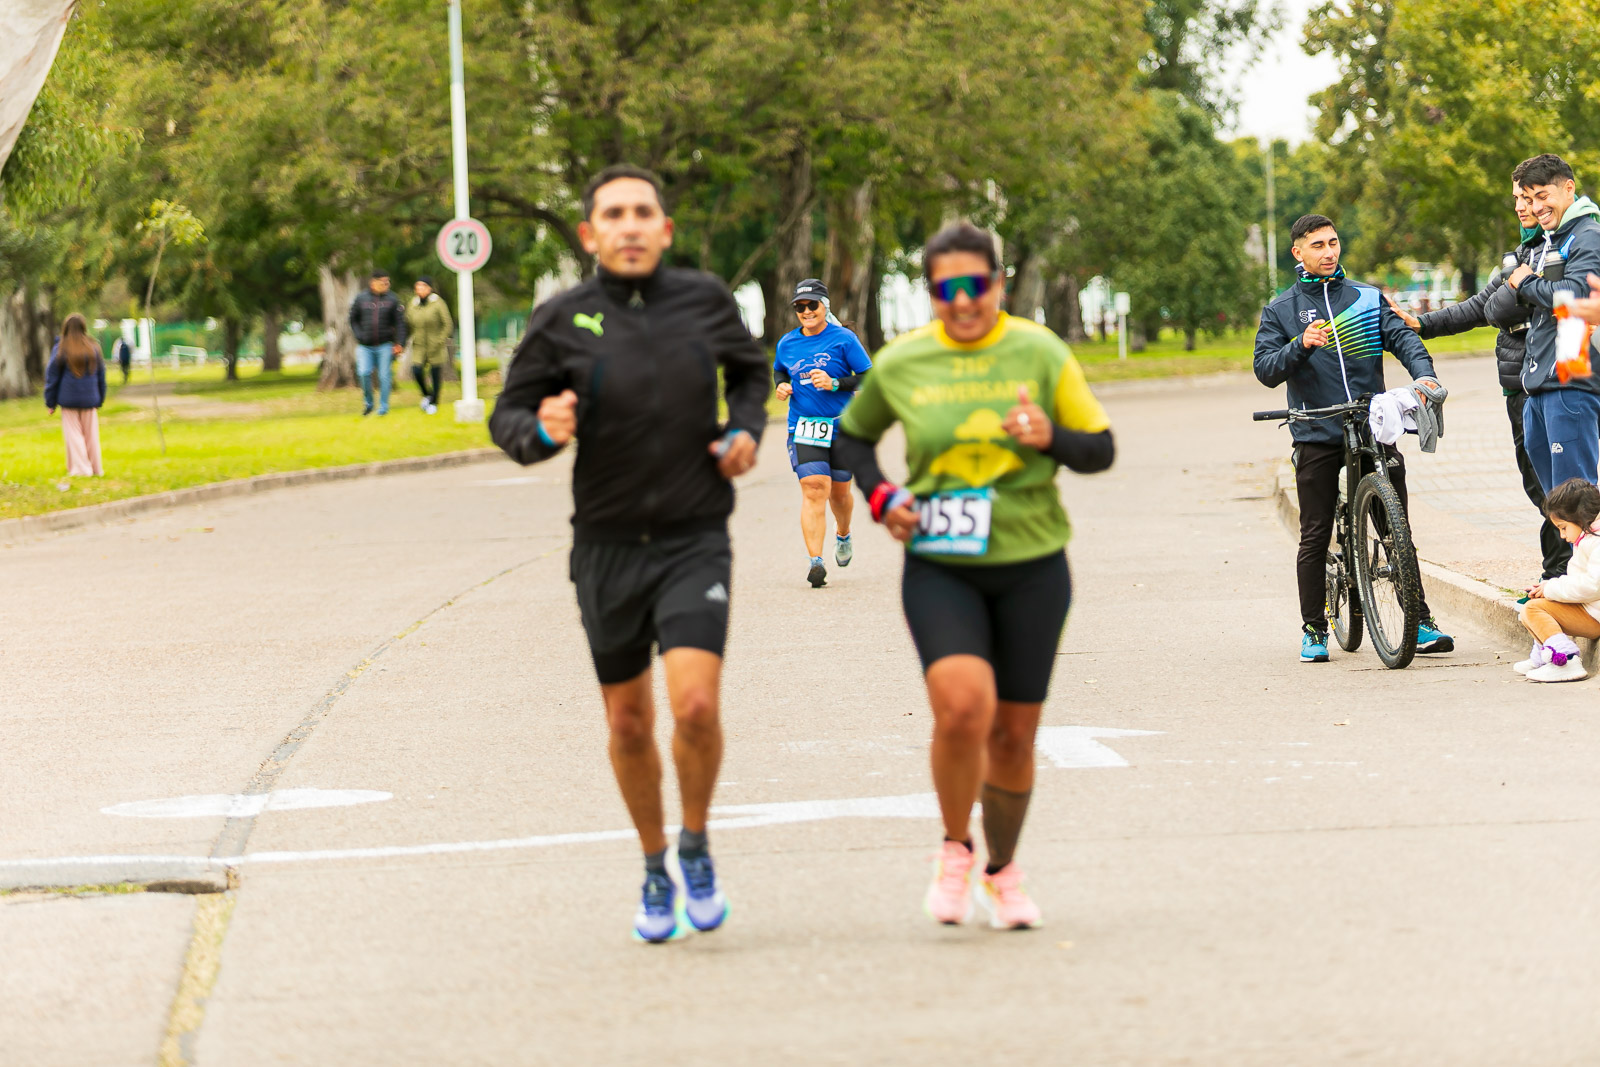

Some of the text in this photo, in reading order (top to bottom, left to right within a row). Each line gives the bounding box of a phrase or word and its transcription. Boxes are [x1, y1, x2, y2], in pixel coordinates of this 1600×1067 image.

[453, 231, 477, 256] 20
[1299, 309, 1317, 323] SF
[801, 420, 829, 439] 119
